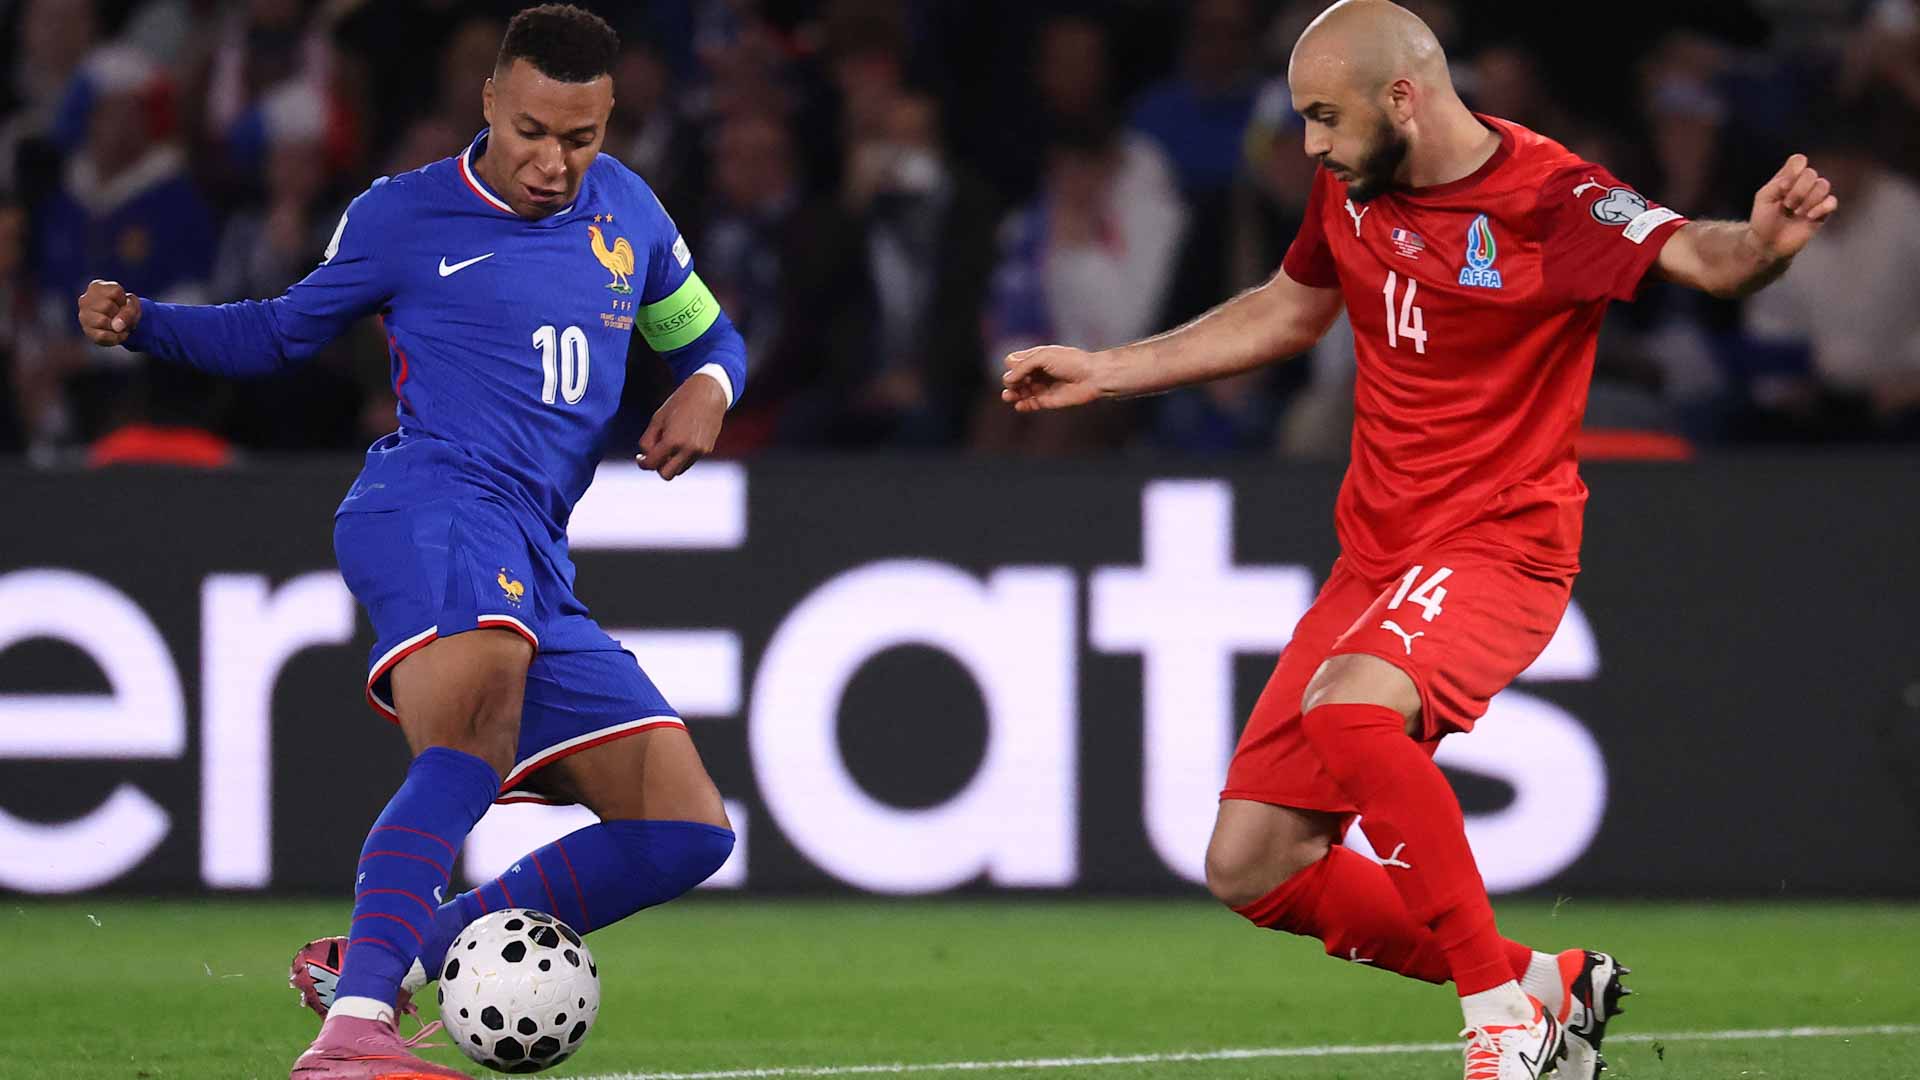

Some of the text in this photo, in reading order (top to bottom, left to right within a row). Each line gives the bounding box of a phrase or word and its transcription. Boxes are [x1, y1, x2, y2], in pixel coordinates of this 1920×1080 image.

[1383, 270, 1428, 354] 14
[1459, 268, 1501, 288] AFFA
[656, 297, 704, 332] RESPECT
[532, 325, 590, 405] 10
[1387, 565, 1454, 622] 14
[0, 567, 358, 893] er
